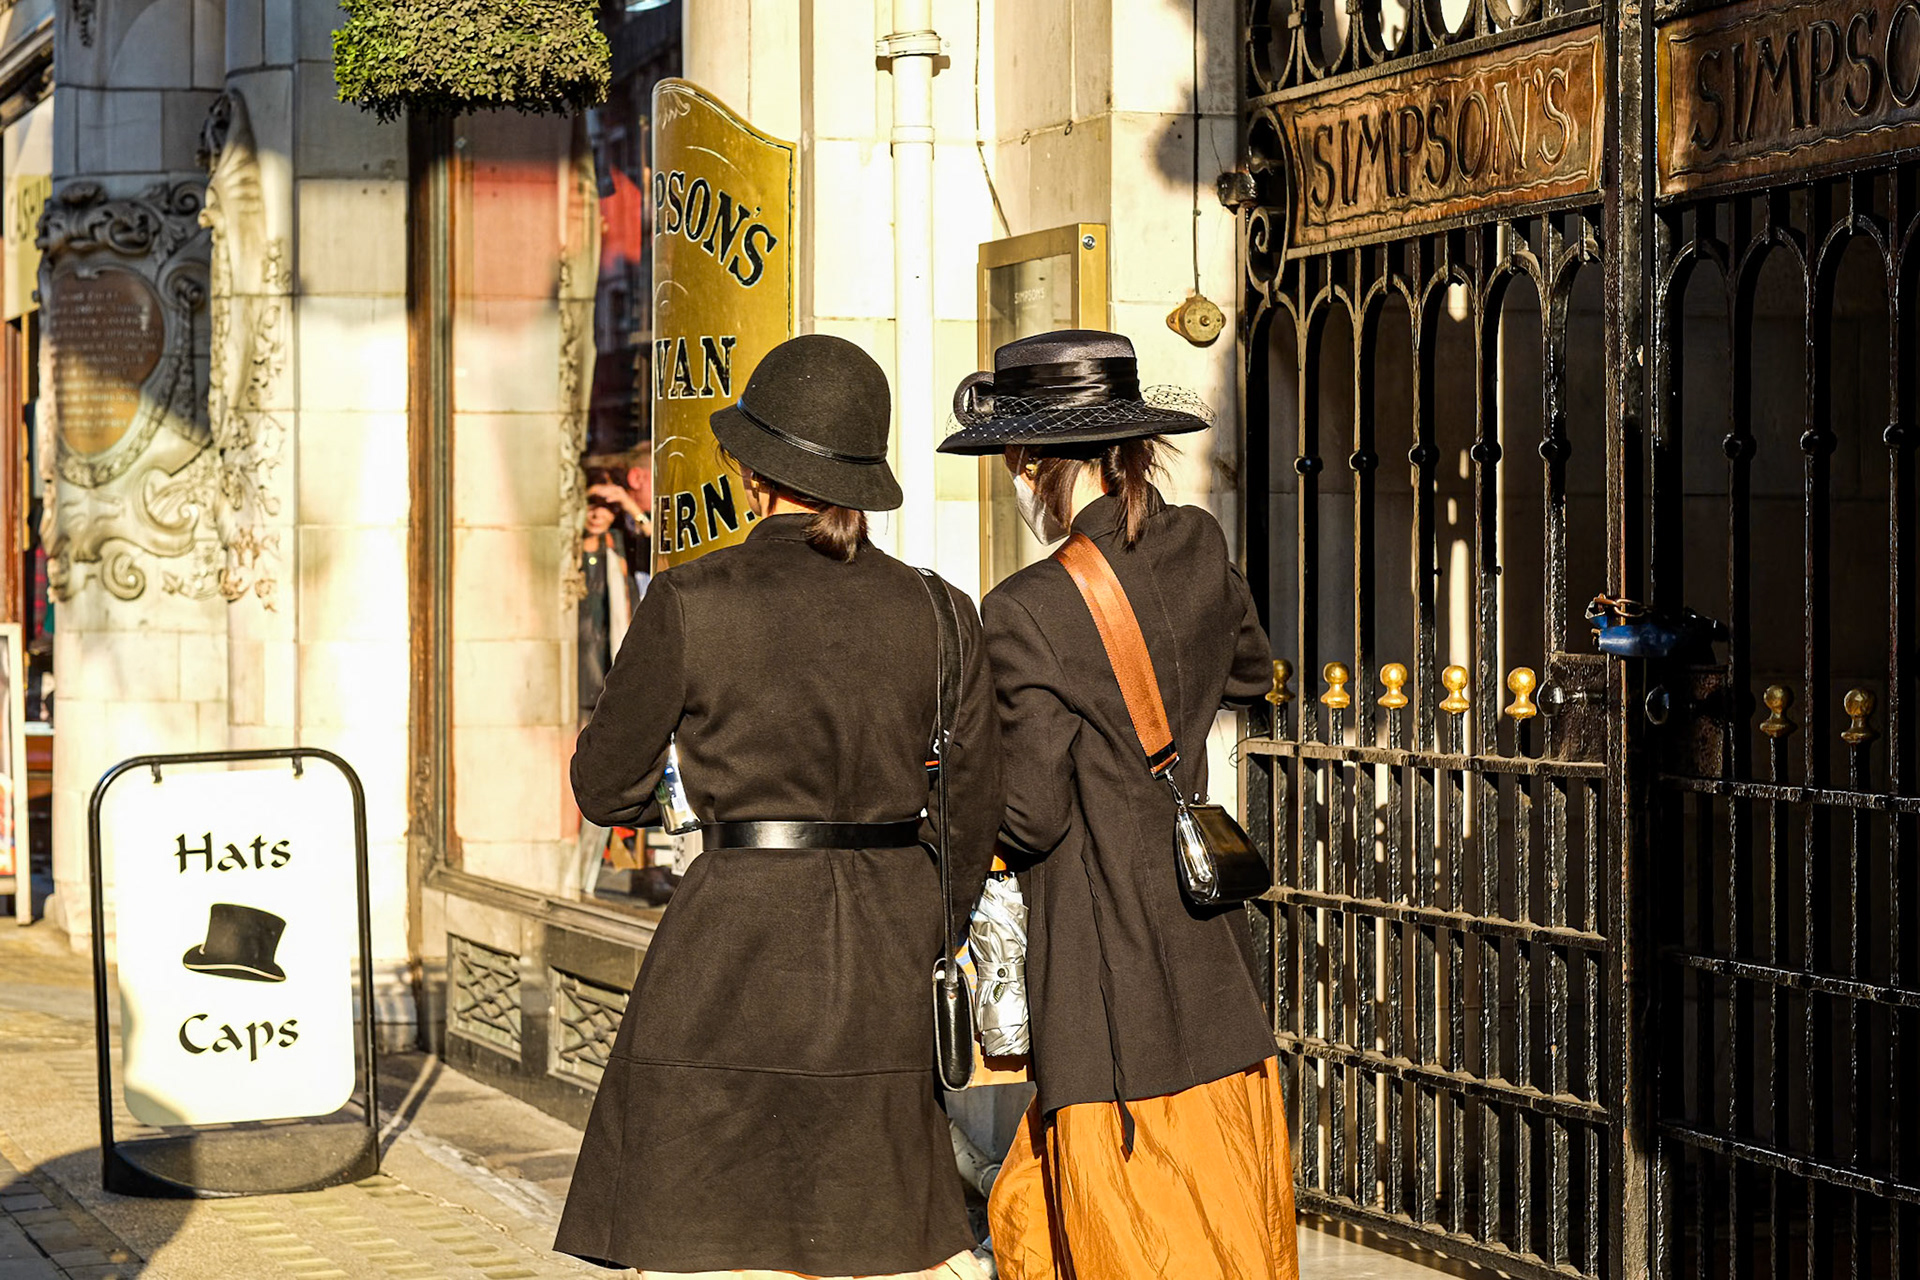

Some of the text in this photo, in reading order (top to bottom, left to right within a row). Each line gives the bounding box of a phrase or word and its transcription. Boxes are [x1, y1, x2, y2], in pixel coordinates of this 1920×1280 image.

[1311, 67, 1570, 210] SIMPSON'S
[174, 831, 291, 874] Hats
[178, 1013, 299, 1062] Caps
